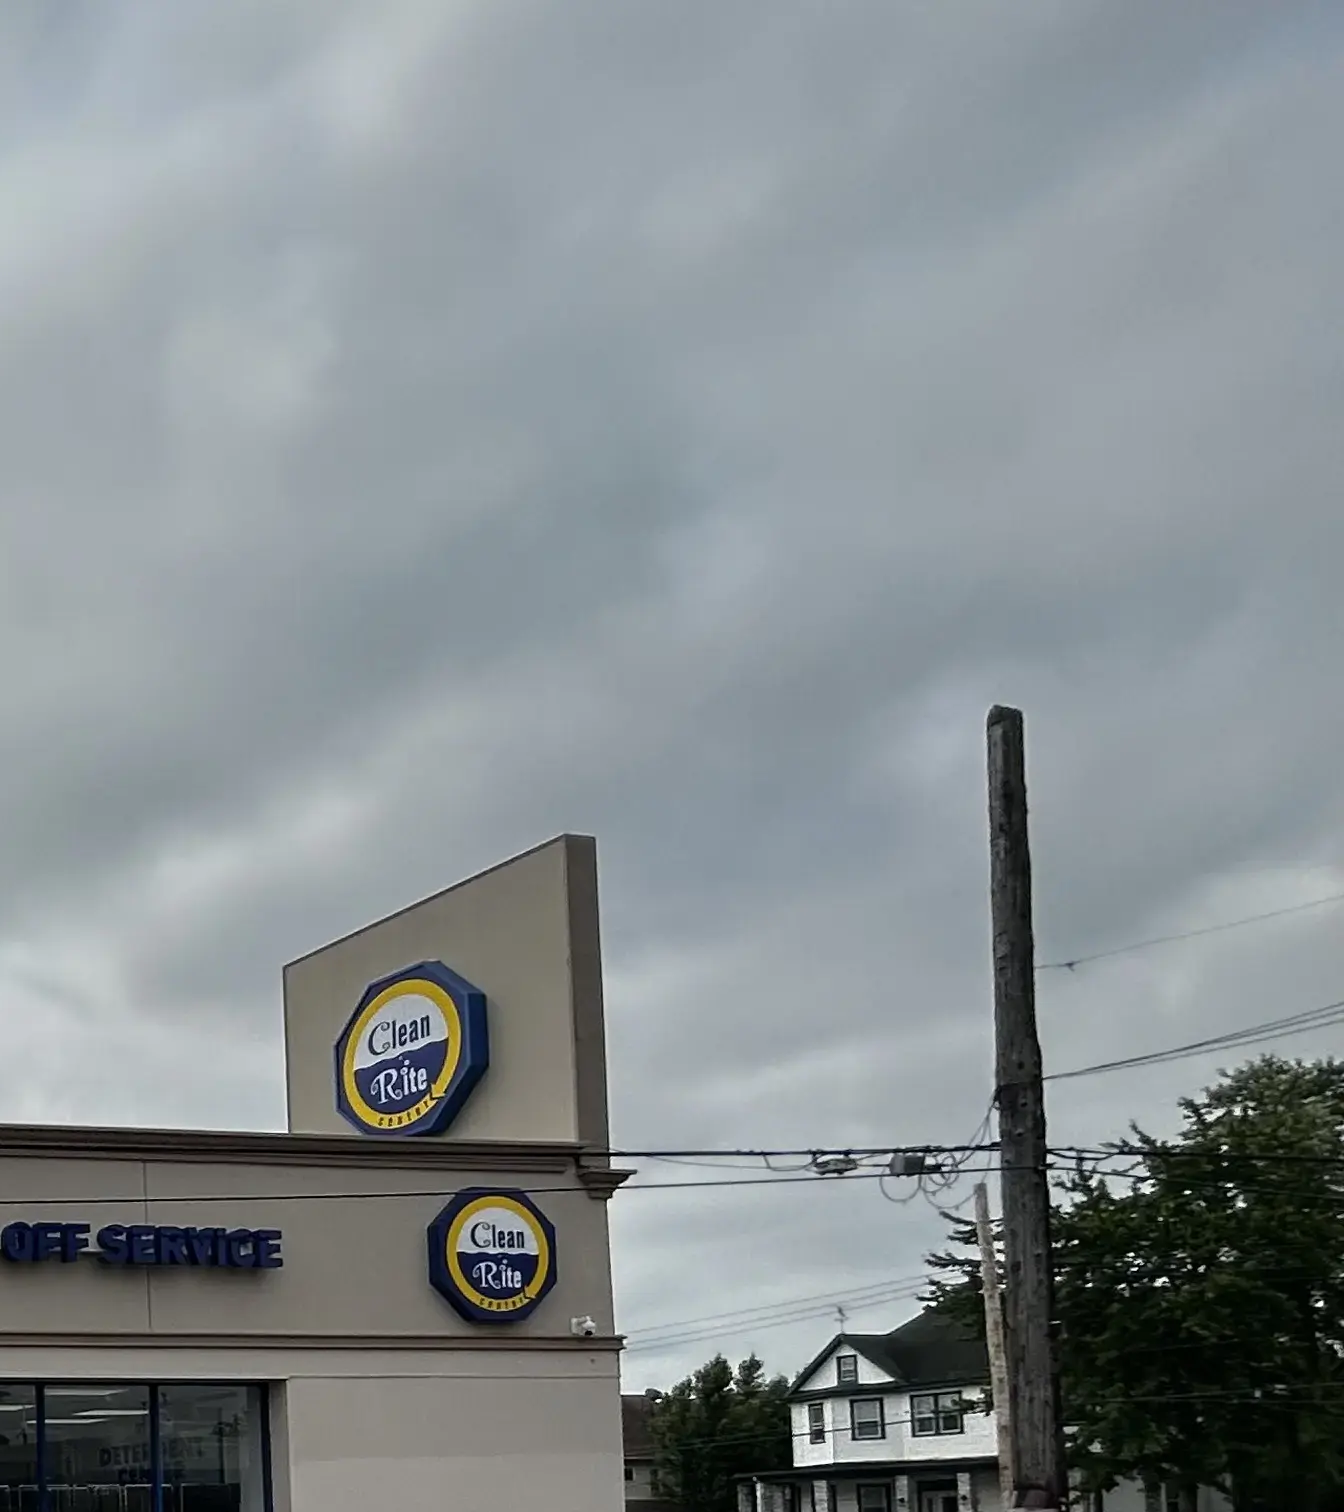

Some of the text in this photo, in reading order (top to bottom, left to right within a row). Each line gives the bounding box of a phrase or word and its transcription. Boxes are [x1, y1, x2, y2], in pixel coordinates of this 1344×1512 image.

[368, 1014, 430, 1056] Clean
[370, 1066, 428, 1105] Rite
[1, 1221, 91, 1263] OFF
[97, 1223, 283, 1269] SERVICE
[470, 1221, 525, 1249] Clean
[472, 1261, 522, 1290] Rite
